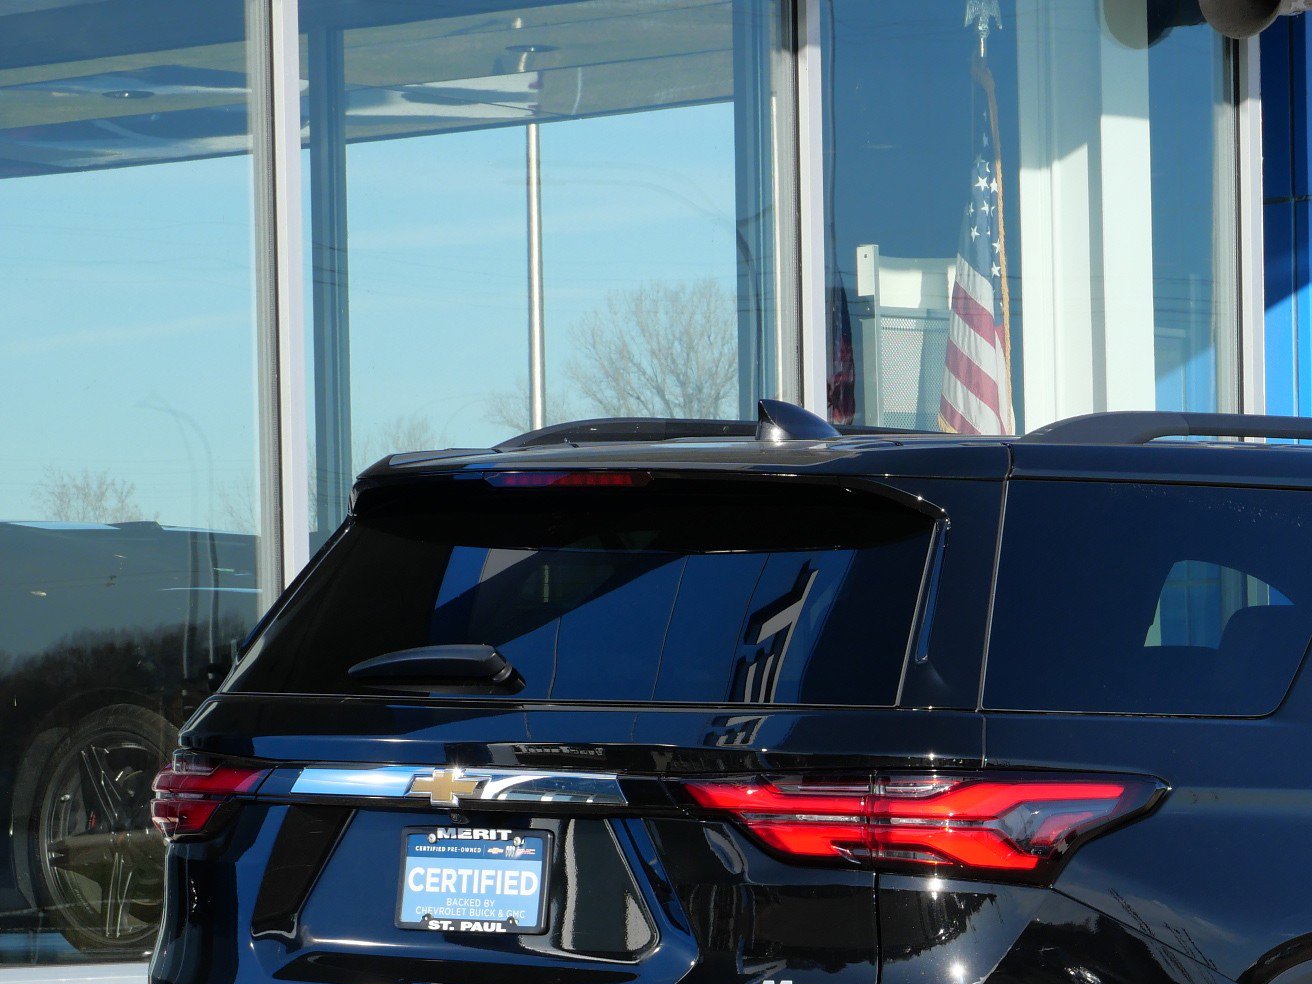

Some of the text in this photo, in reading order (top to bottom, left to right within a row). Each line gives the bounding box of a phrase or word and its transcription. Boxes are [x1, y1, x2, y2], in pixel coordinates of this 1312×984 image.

[437, 828, 512, 841] MERIT
[408, 866, 538, 896] CERTIFIED
[446, 898, 495, 908] BACKED BY
[415, 906, 466, 916] CHEVROLET
[469, 908, 495, 917] BUICK
[506, 910, 525, 919] GMC
[428, 920, 507, 933] ST. PAUL
